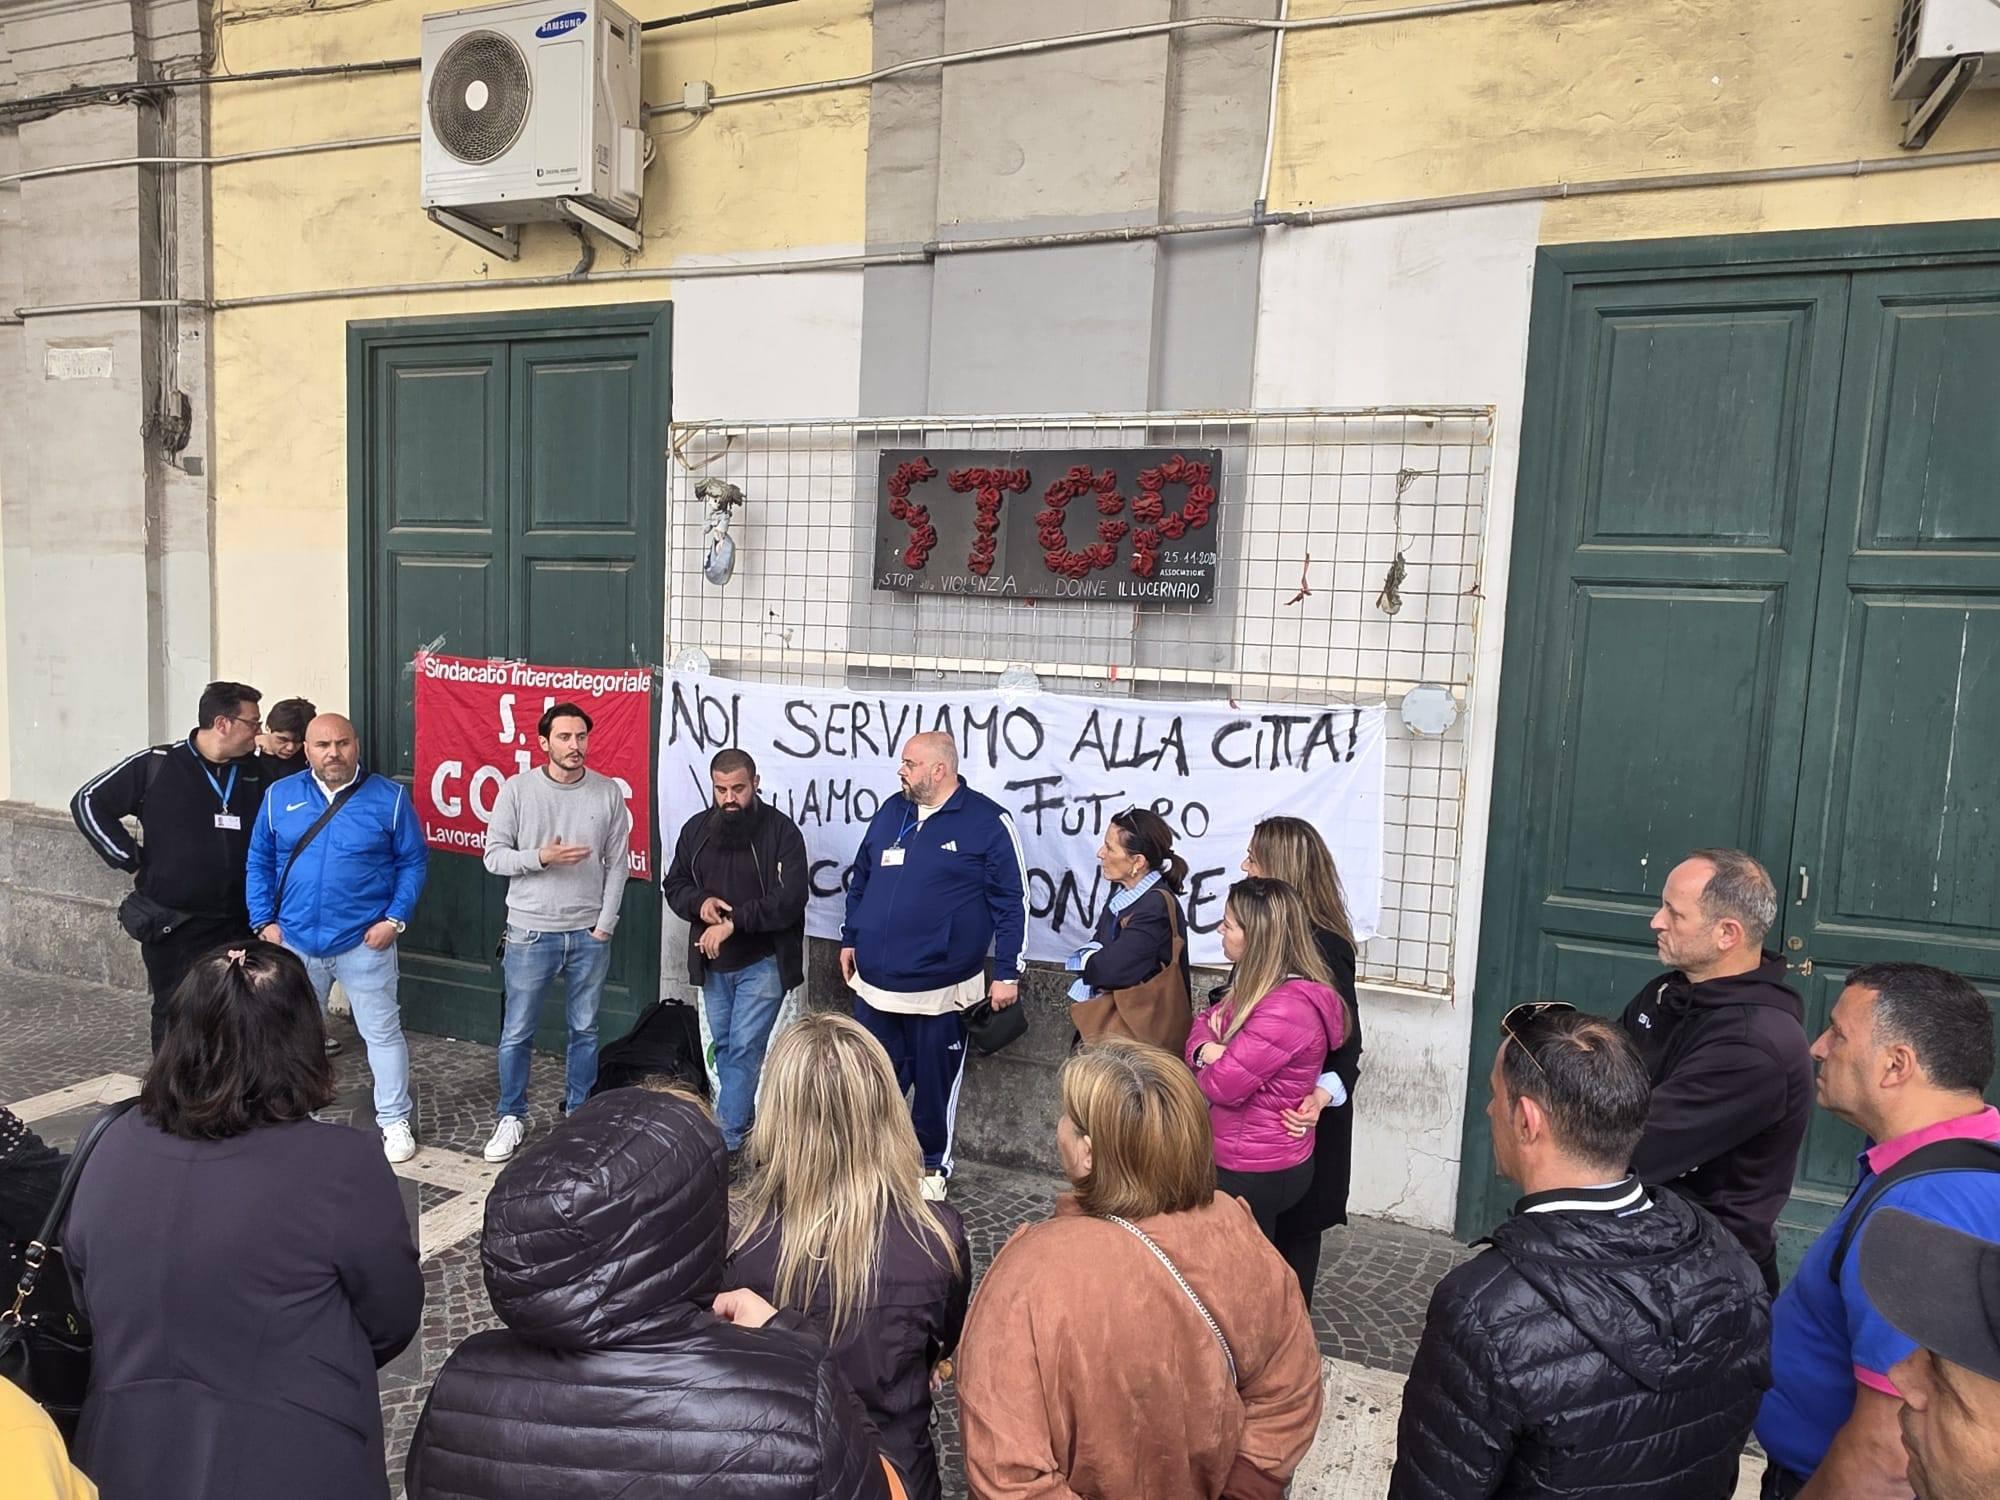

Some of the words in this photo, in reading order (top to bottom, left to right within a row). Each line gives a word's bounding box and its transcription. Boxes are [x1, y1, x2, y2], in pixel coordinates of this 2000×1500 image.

[541, 17, 583, 33] SAMSUNG
[887, 454, 1216, 578] STOP
[882, 572, 914, 588] STOP
[1055, 578, 1107, 597] DONNE
[1131, 580, 1200, 599] LUCERNAIO
[424, 657, 507, 685] Sindacato
[510, 664, 651, 698] Intercategoriale
[669, 680, 741, 753] NOI
[1069, 708, 1190, 777] ALLA
[1003, 775, 1210, 840] FUTRO
[425, 821, 488, 850] Lavorat
